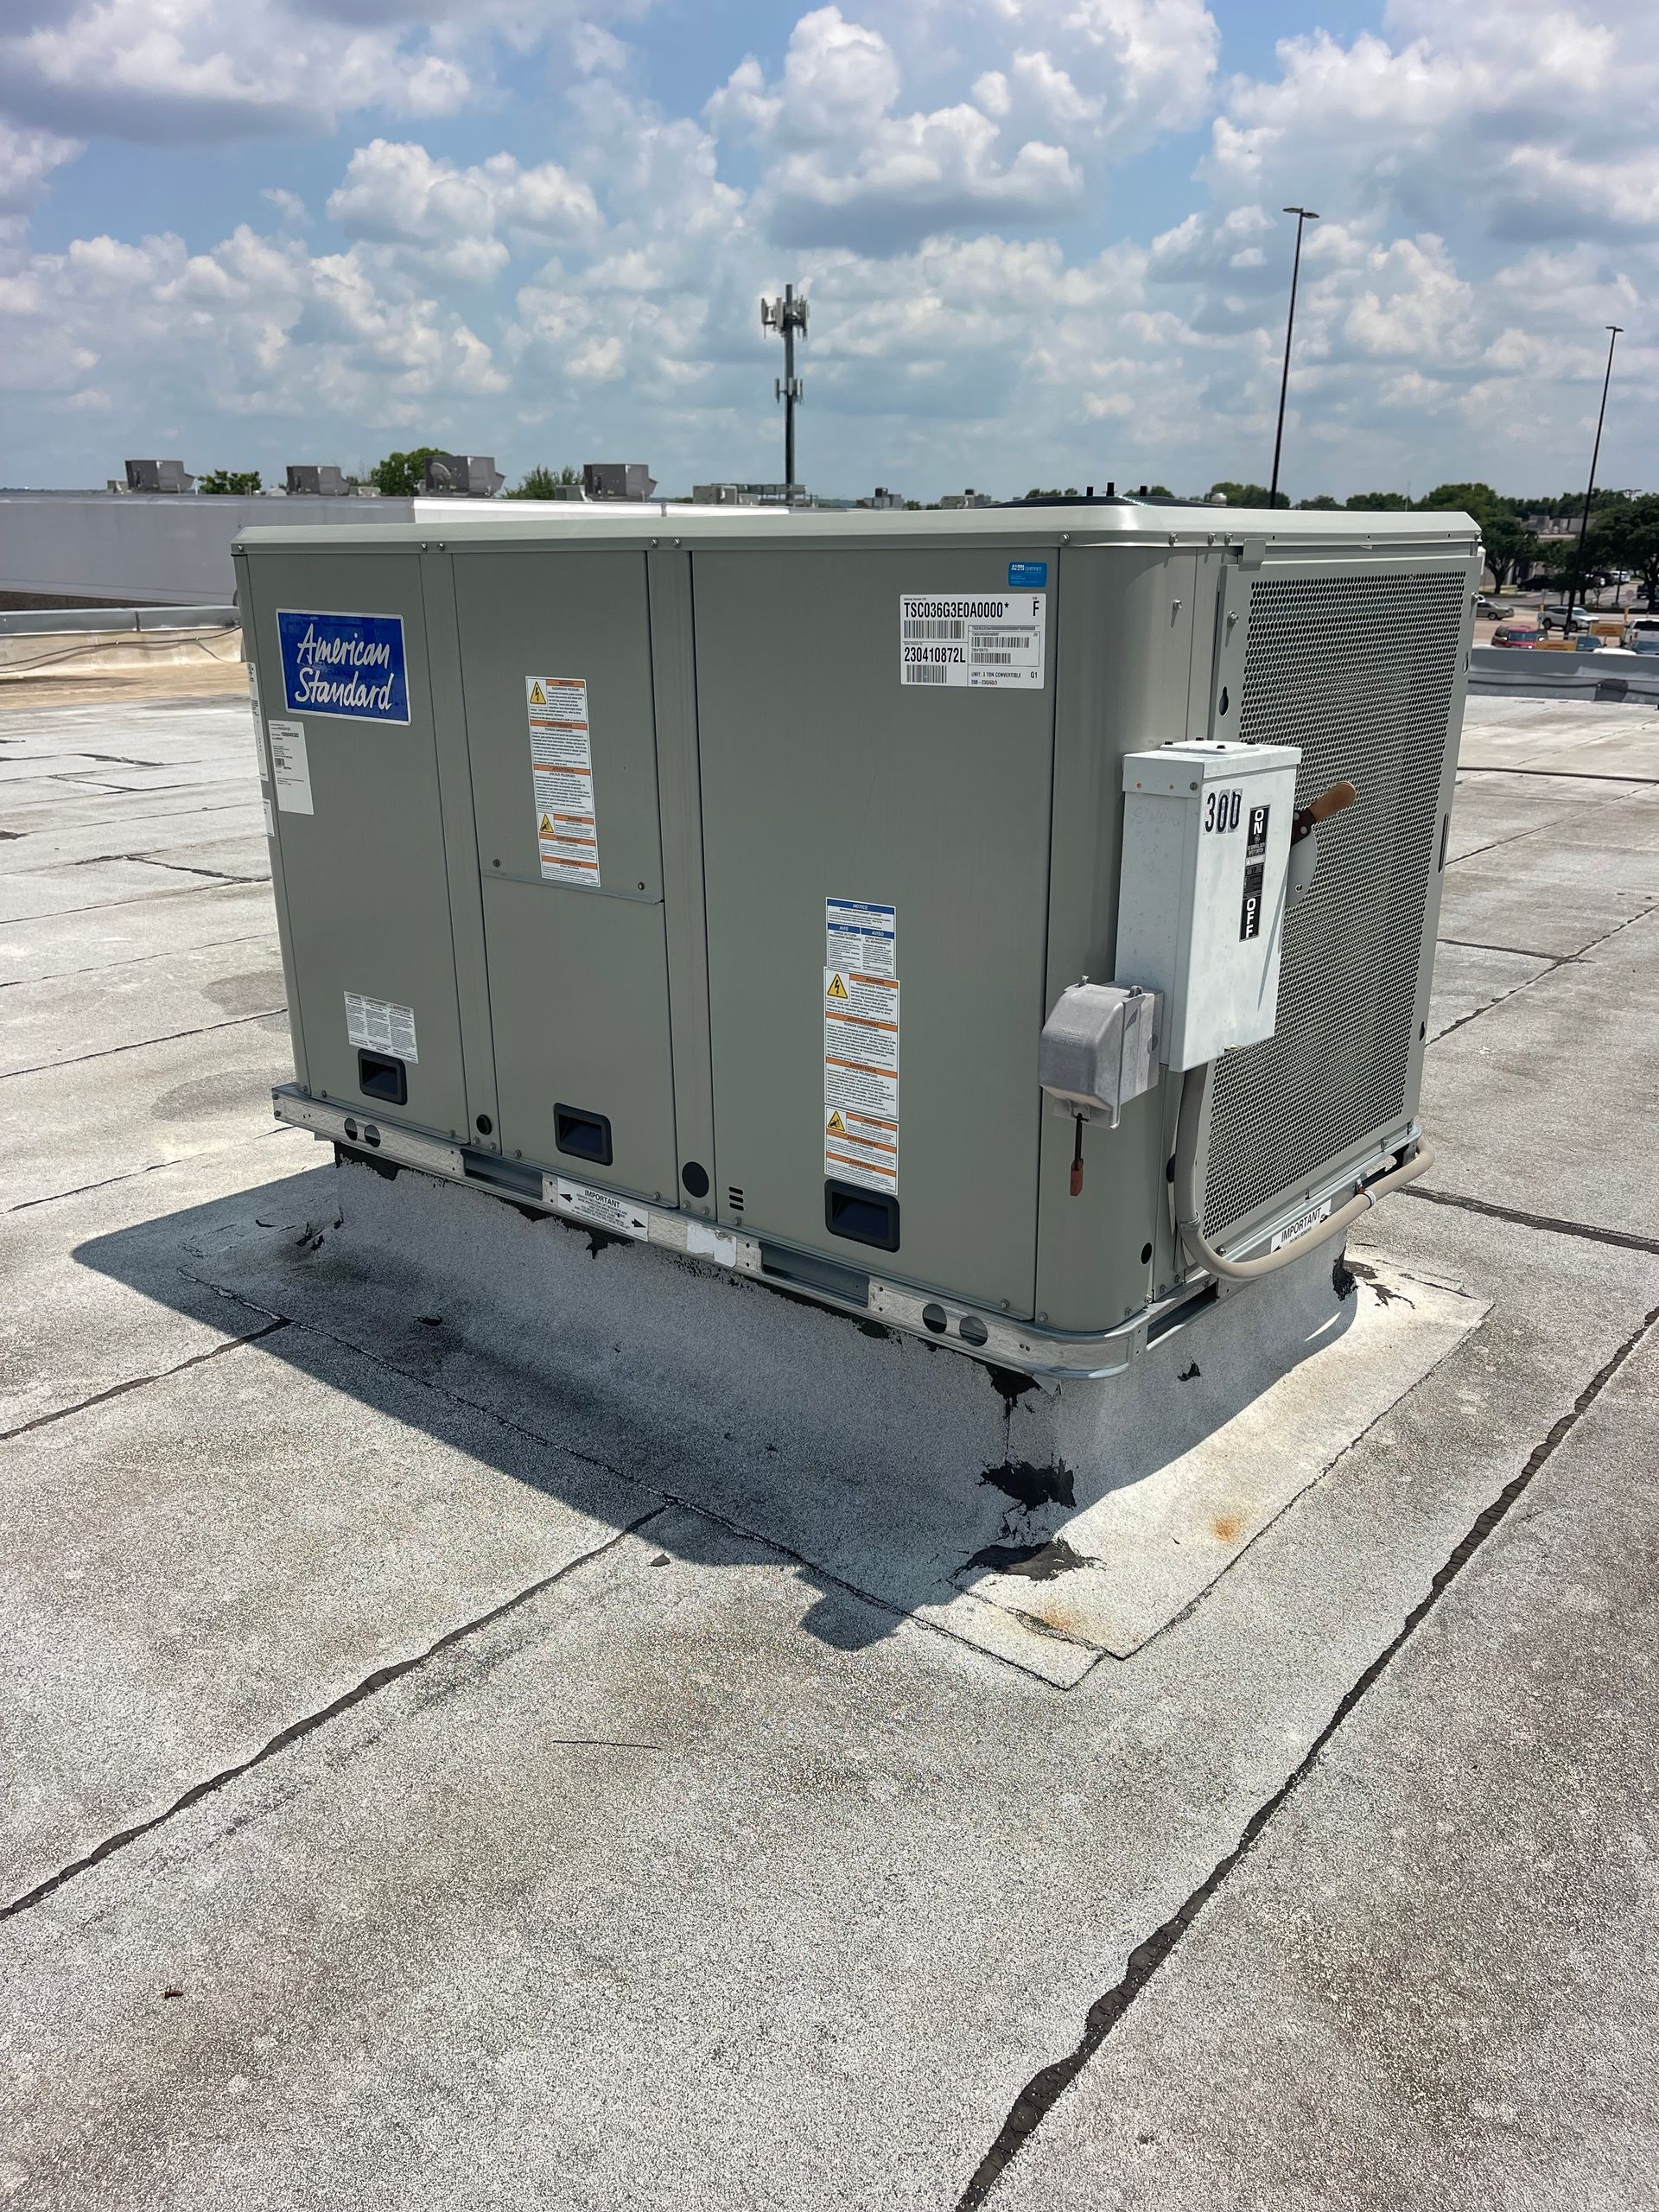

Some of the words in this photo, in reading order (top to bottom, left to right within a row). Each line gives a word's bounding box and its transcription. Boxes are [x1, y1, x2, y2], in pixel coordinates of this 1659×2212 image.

[1033, 601, 1039, 617] F
[296, 623, 391, 670] American
[904, 647, 966, 663] 230410872L
[294, 667, 394, 710] Standard
[1205, 790, 1242, 833] 300
[1253, 809, 1265, 836] ON
[1245, 897, 1257, 938] OFF
[584, 1189, 620, 1209] IMPORTANT
[1281, 1206, 1322, 1243] IMPORTANT
